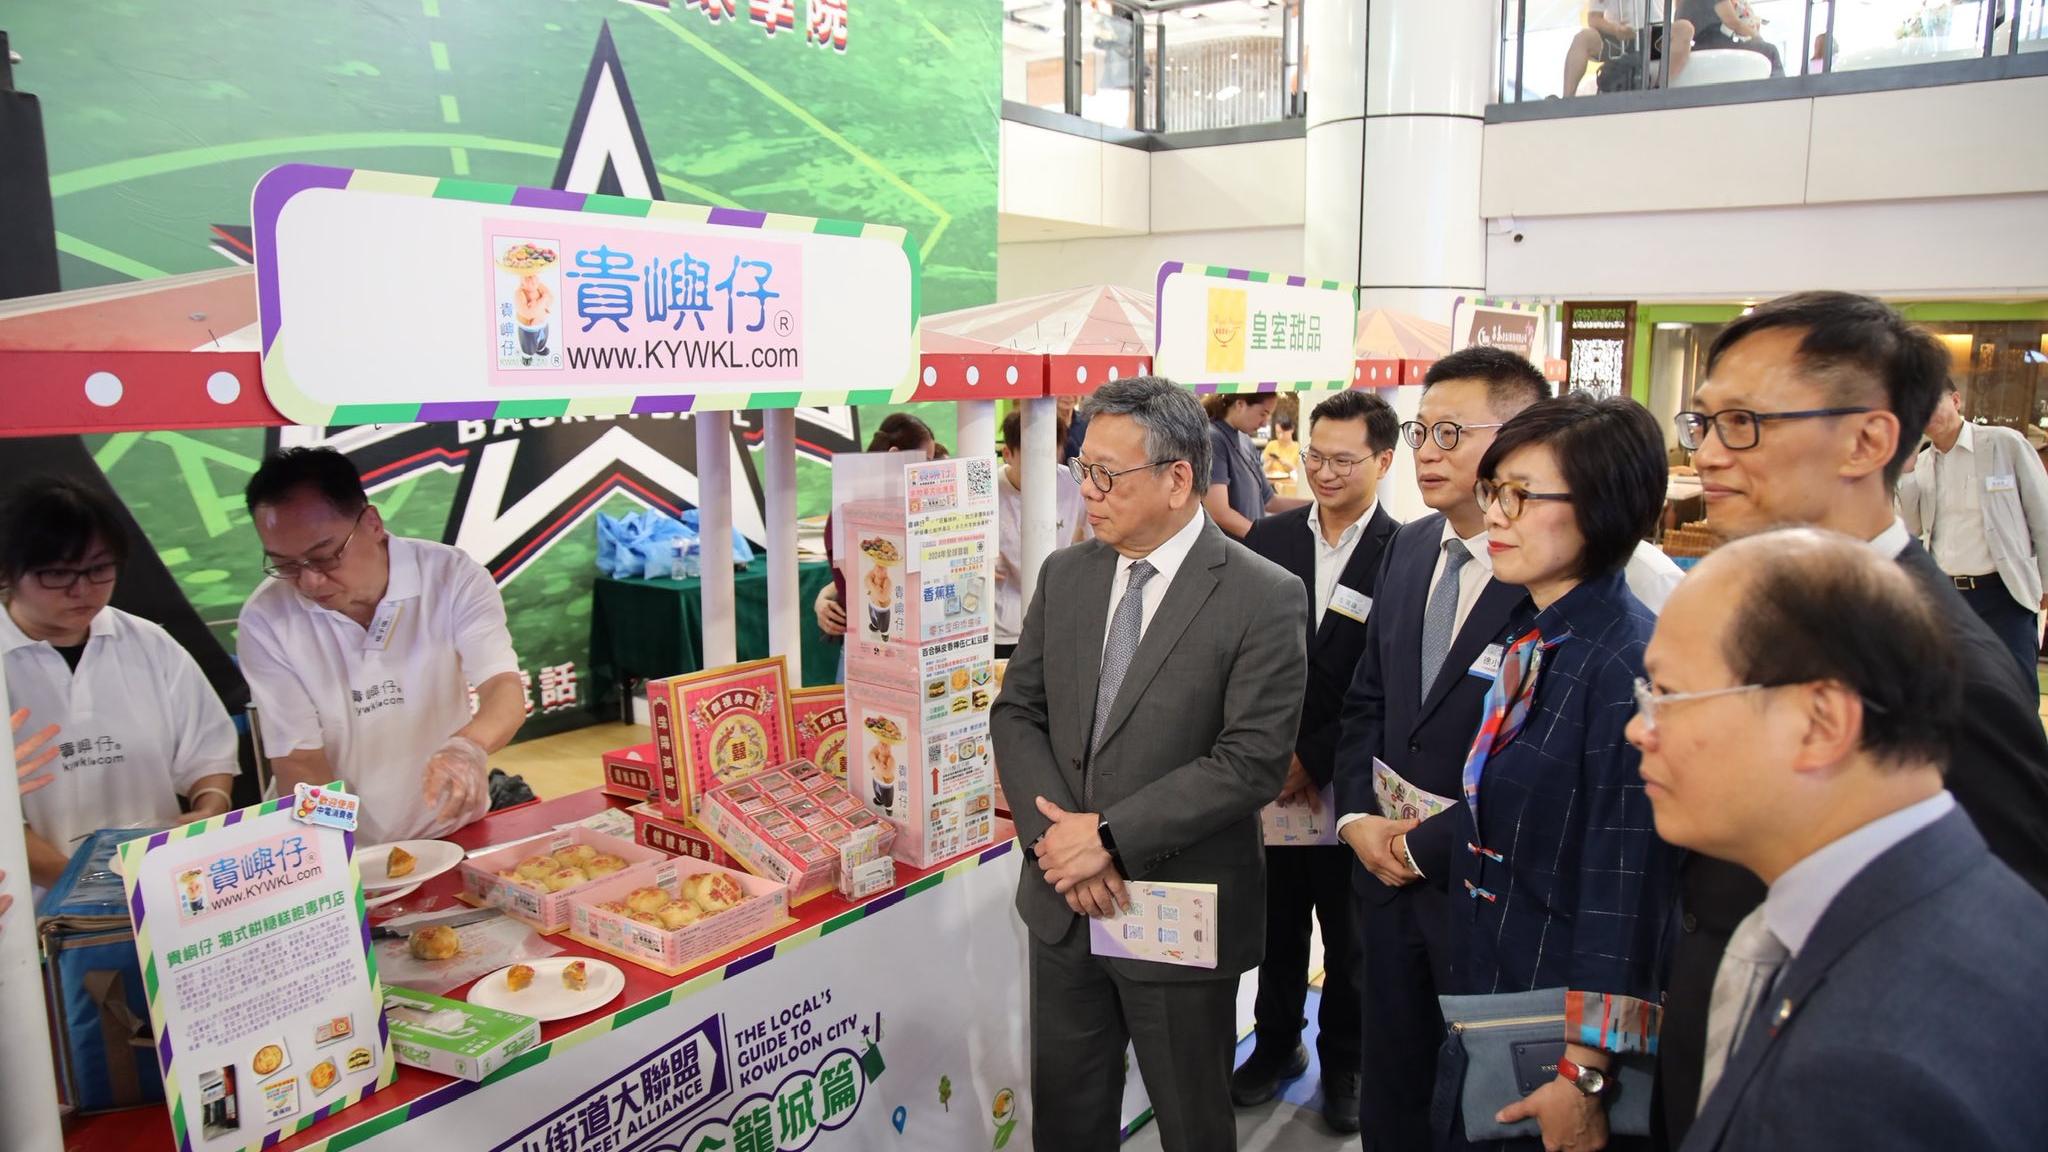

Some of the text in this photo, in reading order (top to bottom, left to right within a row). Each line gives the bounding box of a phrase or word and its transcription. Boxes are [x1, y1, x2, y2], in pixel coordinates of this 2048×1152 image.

[566, 244, 781, 334] 貴嶼仔
[567, 339, 798, 370] www.KYWKL.com
[1250, 311, 1322, 352] 皇室甜品
[923, 583, 957, 602] 香蕉糕
[208, 836, 308, 894] 貴嶼仔
[211, 864, 323, 911] www.KYWKL.com
[735, 989, 832, 1048] THE LOCAL'S
[737, 1019, 812, 1068] GUIDE TO
[739, 1014, 858, 1088] KOWLOON CITY
[522, 1039, 702, 1152] 街道大聯盟
[627, 1079, 703, 1137] ALLIANCE
